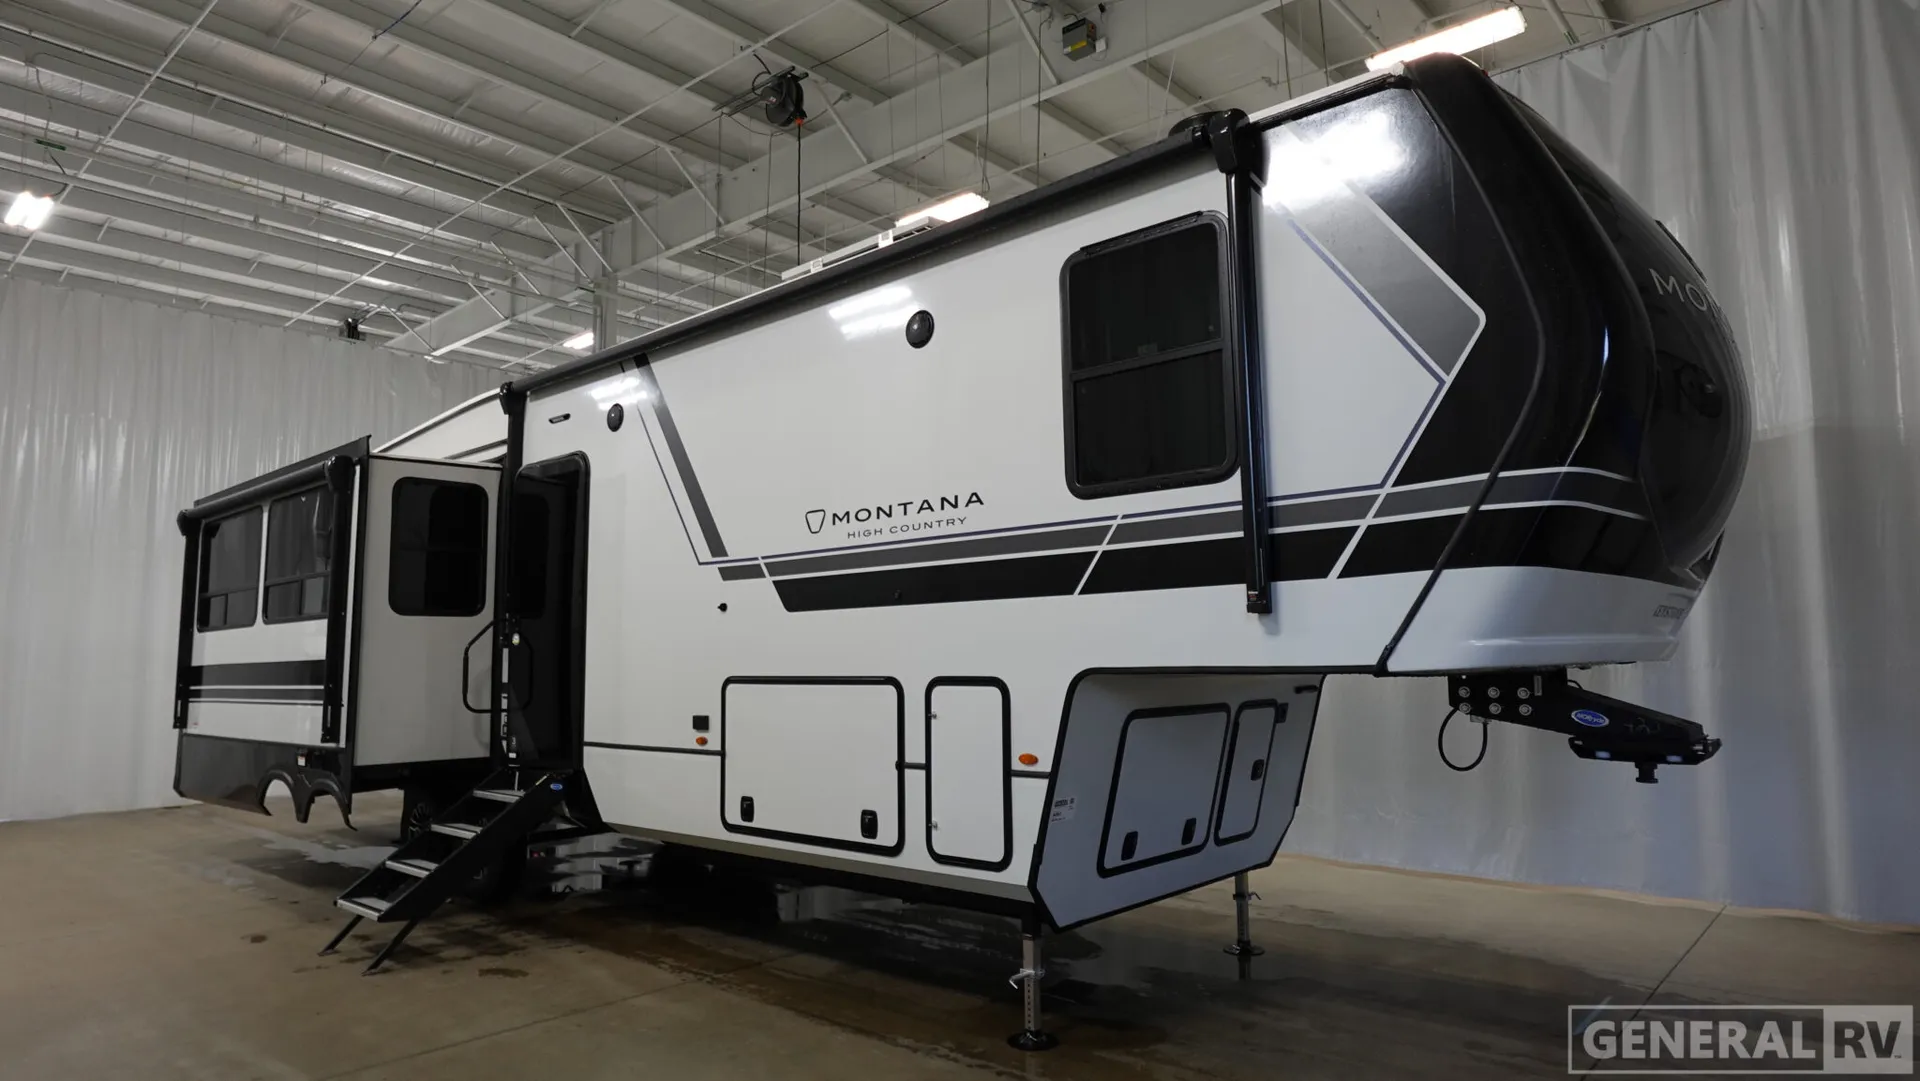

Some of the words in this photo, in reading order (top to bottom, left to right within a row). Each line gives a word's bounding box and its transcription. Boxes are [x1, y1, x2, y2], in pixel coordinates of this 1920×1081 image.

[832, 492, 984, 525] MONTANA
[847, 528, 883, 539] HIGH
[889, 516, 967, 534] COUNTRY
